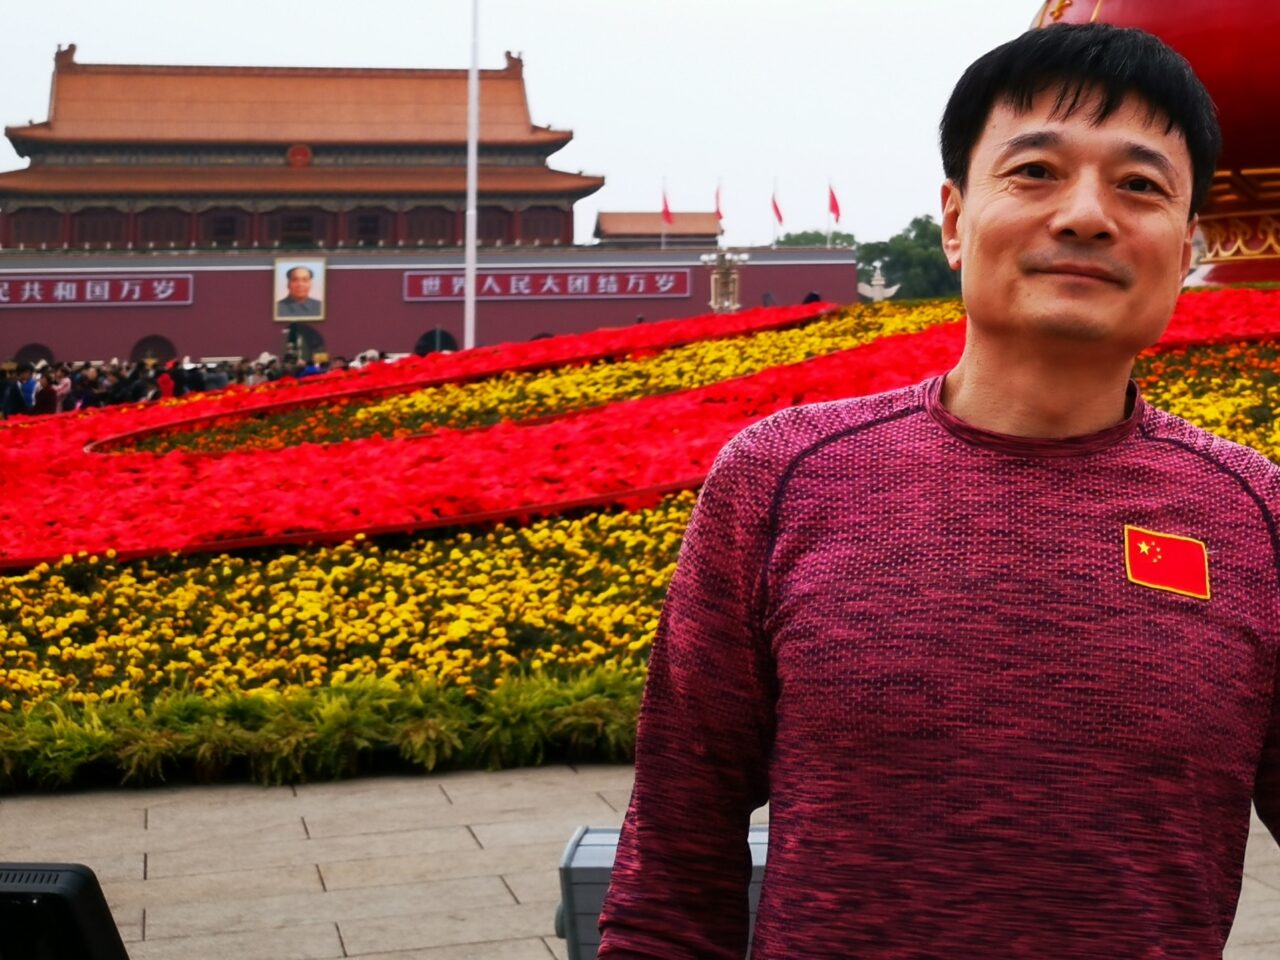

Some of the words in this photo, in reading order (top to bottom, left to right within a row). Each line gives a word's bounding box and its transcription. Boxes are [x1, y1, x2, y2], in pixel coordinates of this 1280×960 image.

[421, 274, 676, 296] 世界人民大团结万岁
